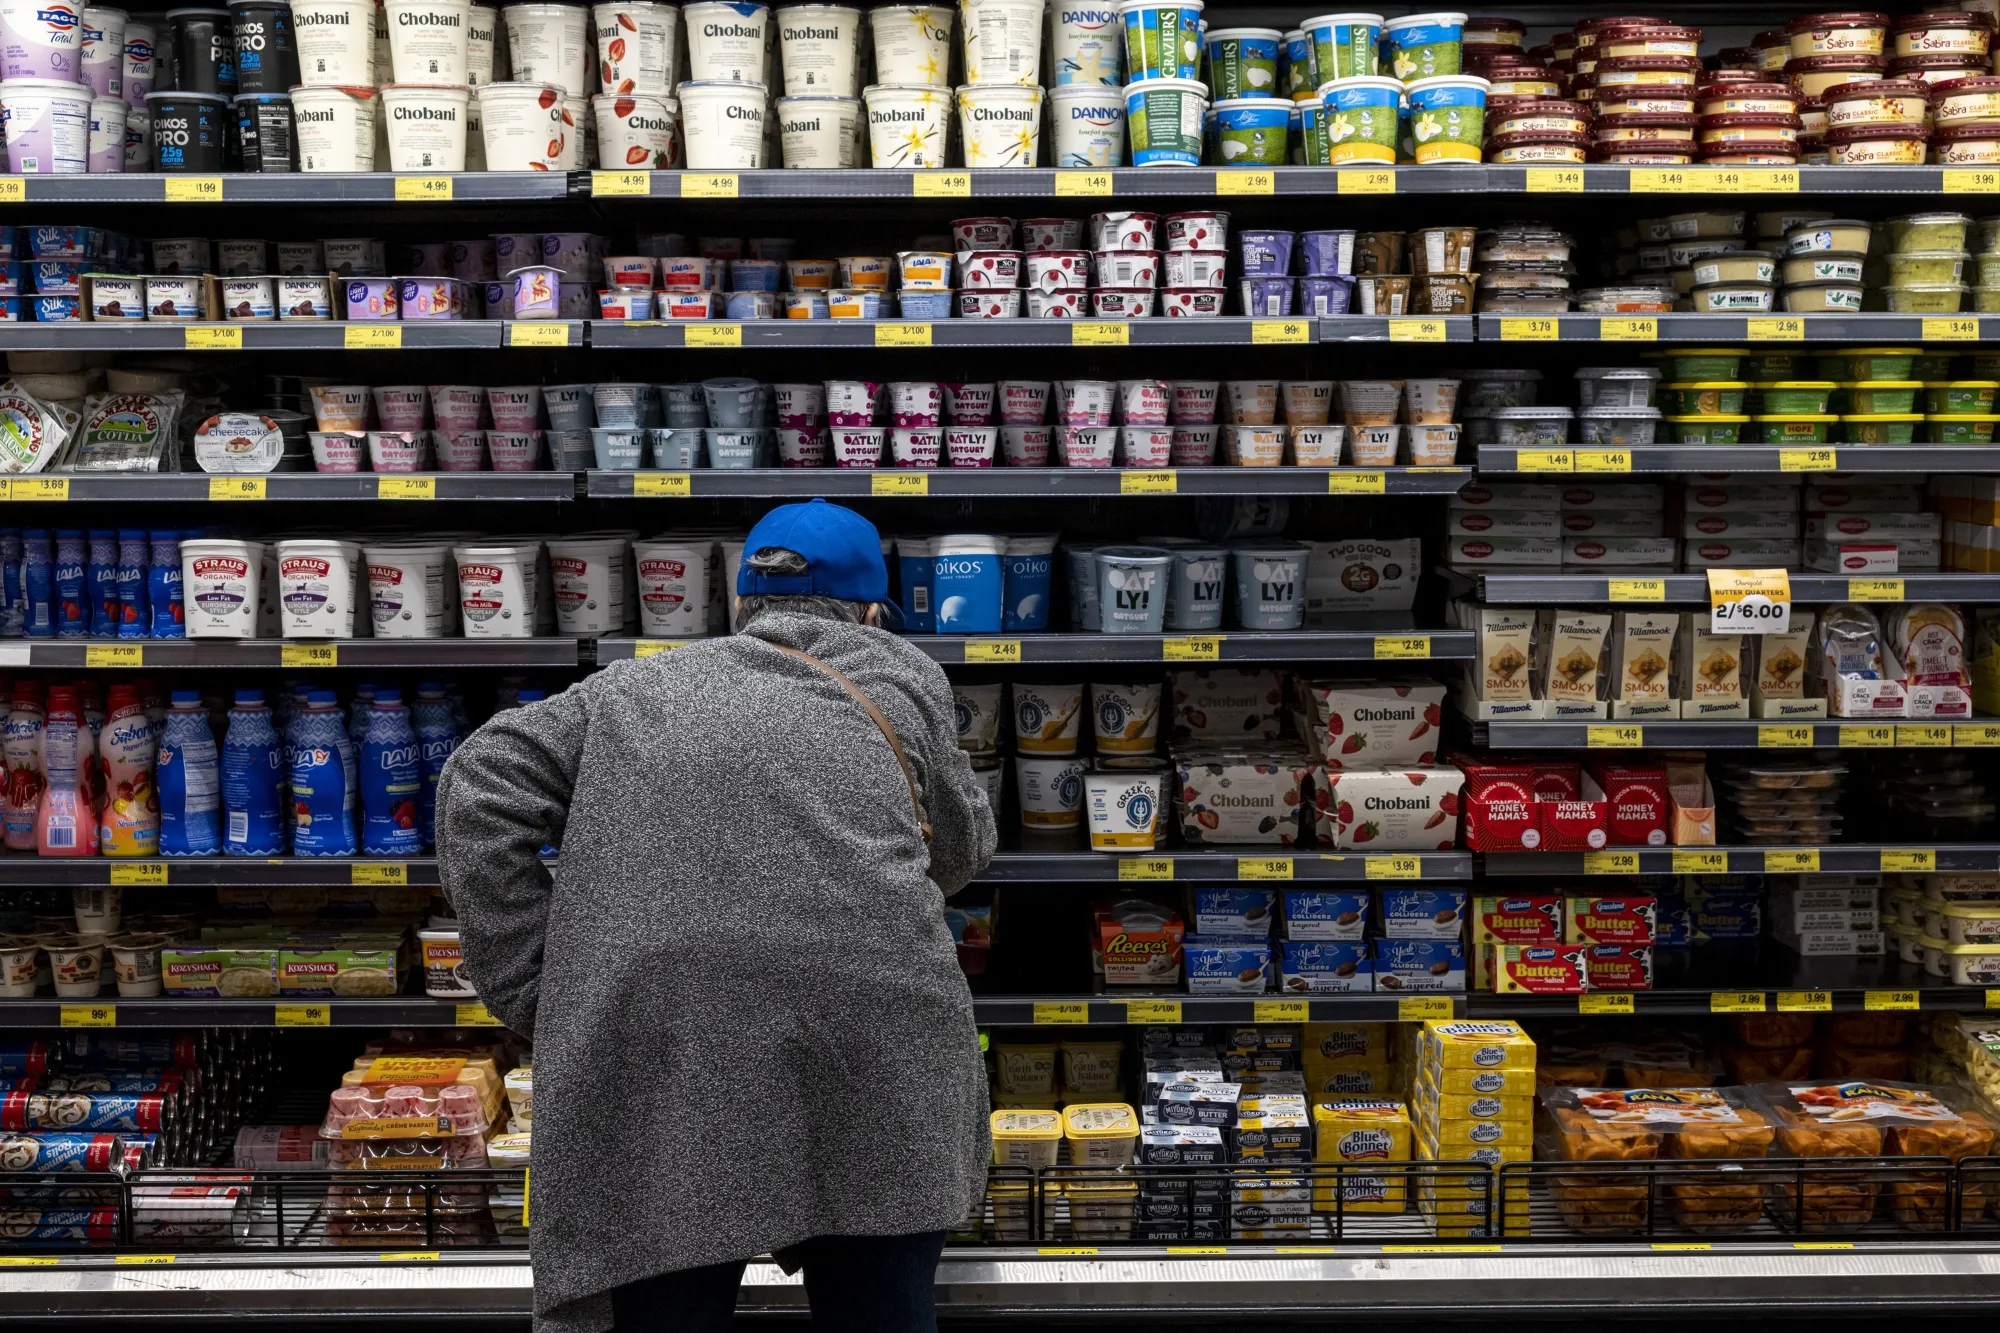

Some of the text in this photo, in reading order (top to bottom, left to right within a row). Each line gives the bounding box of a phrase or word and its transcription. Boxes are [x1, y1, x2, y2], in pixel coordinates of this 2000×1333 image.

[42, 12, 77, 26] FAGE
[294, 12, 349, 27] Chobani
[399, 12, 460, 27] Chobani
[1062, 11, 1119, 24] DANNON
[234, 22, 264, 34] OIKOS
[704, 25, 761, 39] Chobani
[783, 27, 839, 40] Chobani
[48, 32, 73, 44] Total
[235, 36, 265, 50] PRO
[1924, 38, 1951, 50] Sabra
[1826, 40, 1854, 50] Sabra
[240, 52, 259, 63] 25g
[394, 107, 456, 121] Chobani
[871, 108, 925, 123] Chobani
[974, 108, 1033, 122] Chobani
[1072, 107, 1125, 120] DANNON
[154, 118, 188, 130] OIKOS
[155, 131, 188, 145] PRO
[161, 147, 182, 158] 25g
[1848, 151, 1874, 162] Sabra
[37, 228, 59, 244] Silk
[40, 263, 62, 279] Silk
[95, 280, 130, 291] DANNON
[148, 281, 183, 290] DANNON
[224, 282, 259, 291] DANNON
[284, 281, 321, 290] DANNON
[42, 297, 65, 313] Silk
[209, 427, 268, 437] cheesecake
[1788, 425, 1812, 433] HOPE
[97, 430, 143, 442] COTIJA
[843, 433, 882, 446] OATLY!
[949, 433, 986, 444] OATLY!
[845, 446, 879, 454] OATGURT
[951, 446, 985, 454] OATGURT
[195, 558, 245, 571] STRAUS
[282, 558, 326, 571] STRAUS
[1715, 588, 1784, 597] BUTTER QUARTERS
[1486, 621, 1528, 632] Tillamook
[1628, 626, 1671, 637] Tillamook
[1486, 679, 1528, 689] SMOKY
[1625, 682, 1665, 692] SMOKY
[1696, 682, 1738, 693] SMOKY
[1491, 704, 1532, 714] Tillamook
[1630, 705, 1671, 715] Tillamook
[1699, 702, 1741, 713] Tillamook
[1354, 707, 1415, 722] Chobani
[1210, 794, 1274, 808] Chobani
[1365, 796, 1430, 810] Chobani
[1558, 803, 1593, 811] HONEY
[1491, 803, 1526, 812] HONEY
[1489, 812, 1529, 820] MAMA'S
[1492, 915, 1541, 929] Butter
[1585, 916, 1633, 929] Butter
[1106, 934, 1169, 954] Reese's
[170, 962, 220, 974] KOZYSHACK
[287, 963, 337, 974] KOZYSHACK
[1515, 964, 1565, 978] Butter
[1482, 1047, 1498, 1056] Blue
[1474, 1054, 1504, 1063] Bonnet
[1629, 1093, 1676, 1103] RANA
[1198, 1111, 1228, 1119] BUTTER
[1352, 1131, 1379, 1143] Blue
[1343, 1140, 1391, 1153] Bonnet
